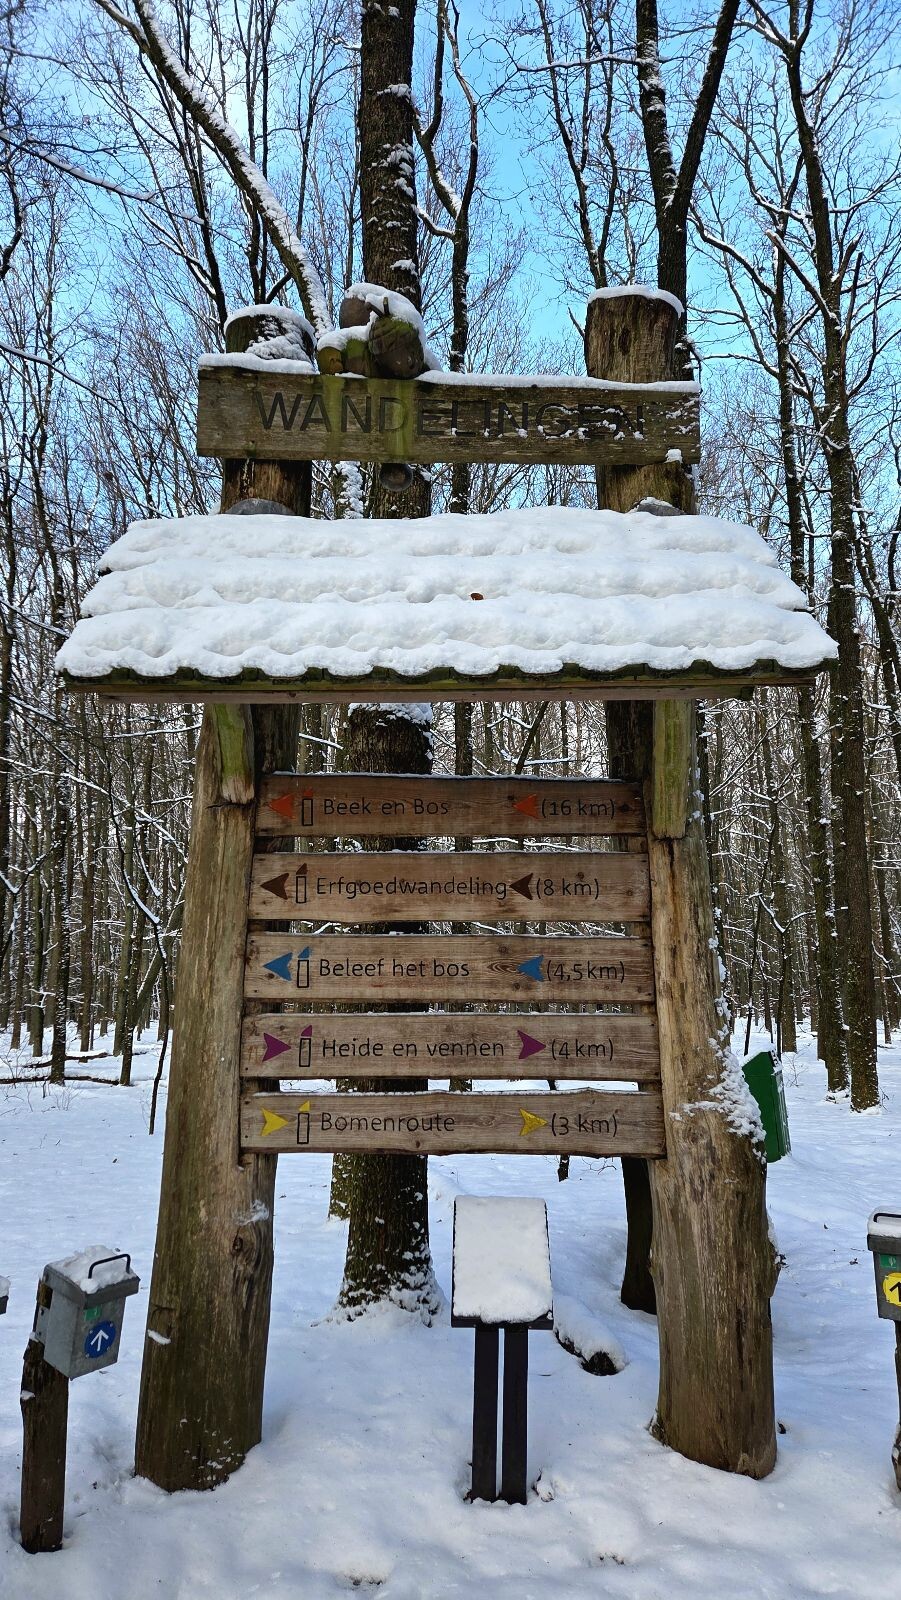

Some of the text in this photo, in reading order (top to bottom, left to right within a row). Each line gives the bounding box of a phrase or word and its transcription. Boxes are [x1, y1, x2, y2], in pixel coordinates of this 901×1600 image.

[254, 390, 644, 440] WANDELINGEN
[323, 799, 616, 818] Beek en Bos (16 km)
[316, 877, 600, 901] Erfgoedwandeling (8 km)
[319, 958, 385, 977] Beleef
[392, 958, 426, 977] het
[434, 960, 470, 977] bos
[322, 1038, 384, 1057] Heide
[393, 1042, 418, 1057] en
[426, 1042, 504, 1057] vennen
[321, 1112, 618, 1136] Bomenroute (3 km)
